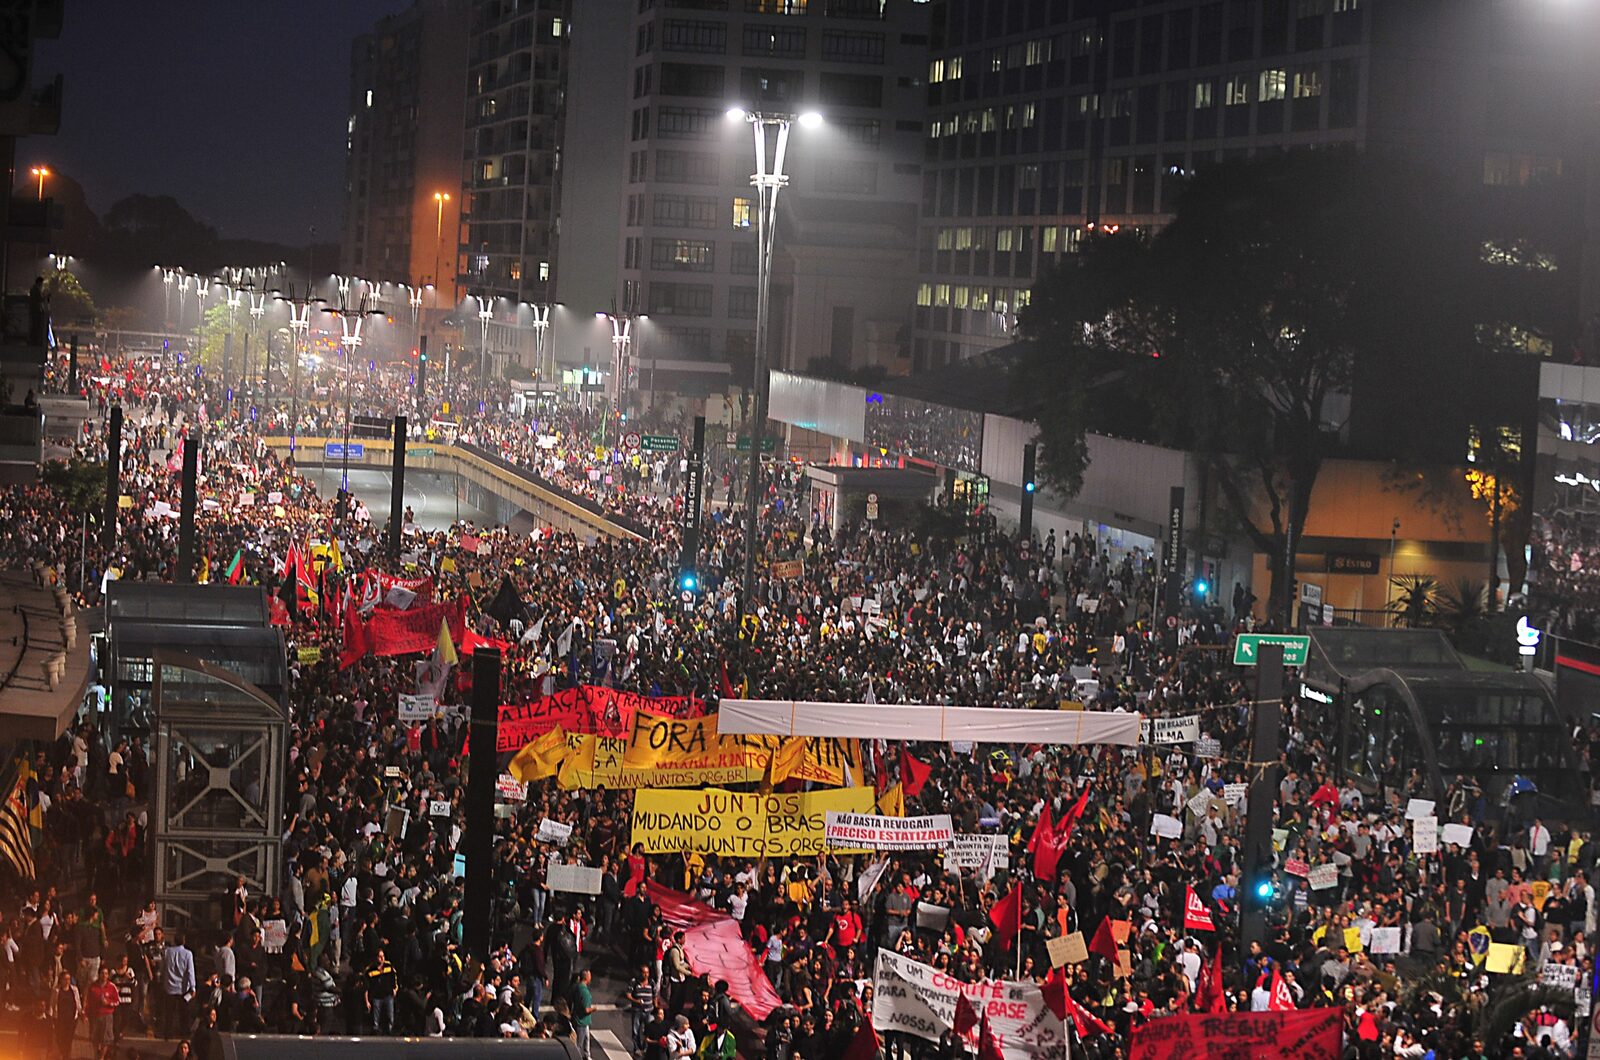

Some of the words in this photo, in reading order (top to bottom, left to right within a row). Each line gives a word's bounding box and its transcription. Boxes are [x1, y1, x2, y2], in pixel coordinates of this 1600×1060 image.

[688, 471, 697, 498] Cintra
[687, 500, 695, 519] Bela
[631, 711, 706, 753] FORA
[1157, 721, 1168, 730] EM
[1152, 730, 1184, 743] ILMA
[697, 794, 800, 814] JUNTOS
[633, 811, 721, 831] MUDANDO
[736, 816, 752, 831] O
[767, 813, 826, 834] BRAS
[836, 814, 852, 825] NÃO
[853, 816, 881, 828] BASTA
[883, 818, 934, 830] REVOGAR!
[831, 826, 876, 839] PRECISO
[879, 828, 950, 841] ESTATIZAR!
[647, 835, 846, 853] WWW.JUNTOS.ORG.
[880, 953, 899, 969] POR
[906, 964, 923, 980] UM
[878, 985, 907, 998] PARA
[987, 1001, 1028, 1019] BASE
[890, 1013, 937, 1034] NOSSA
